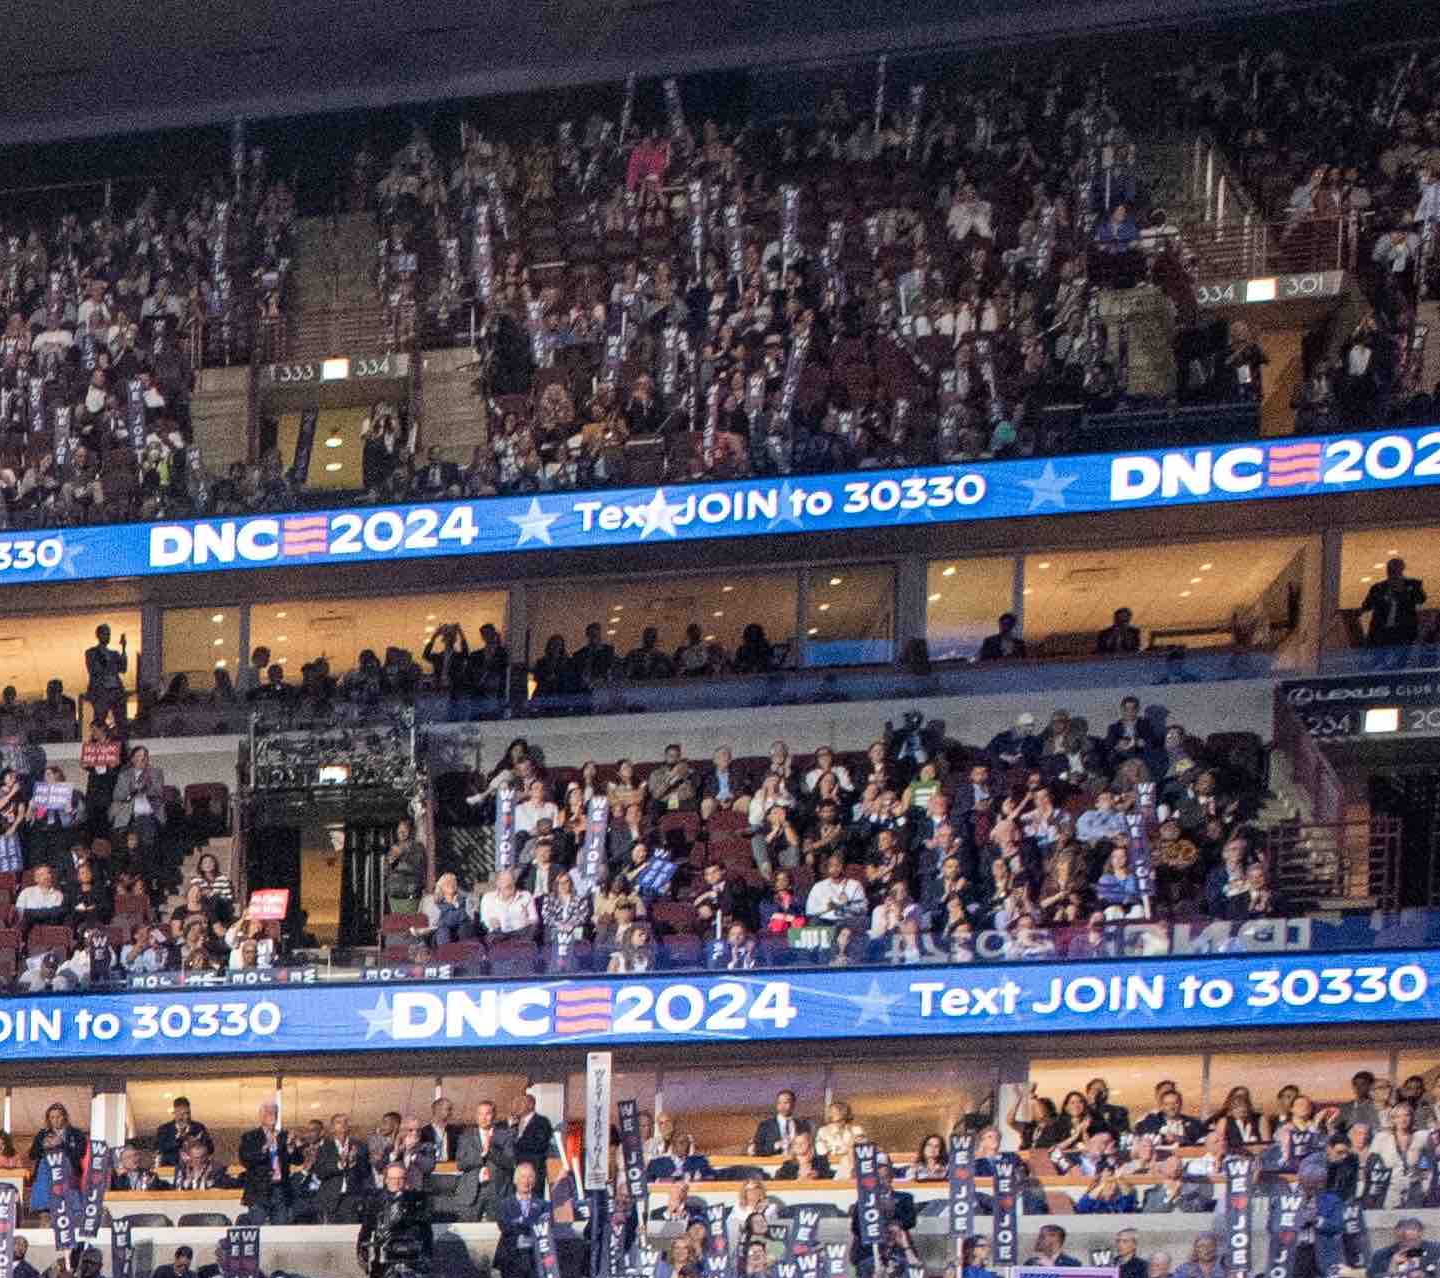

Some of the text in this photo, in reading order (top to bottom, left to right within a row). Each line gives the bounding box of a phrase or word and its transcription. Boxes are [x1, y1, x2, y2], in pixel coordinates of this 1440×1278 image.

[674, 491, 778, 526] JOIN
[789, 488, 833, 517] to
[843, 474, 986, 512] 30330
[1110, 446, 1264, 500] DNC
[149, 507, 478, 567] DNC 2024
[392, 982, 799, 1041] DNC 2024
[909, 966, 1428, 1016] Text JOIN to 30330
[74, 1009, 121, 1040] to
[131, 1002, 281, 1040] 30330
[1230, 1161, 1249, 1265] WE JOE
